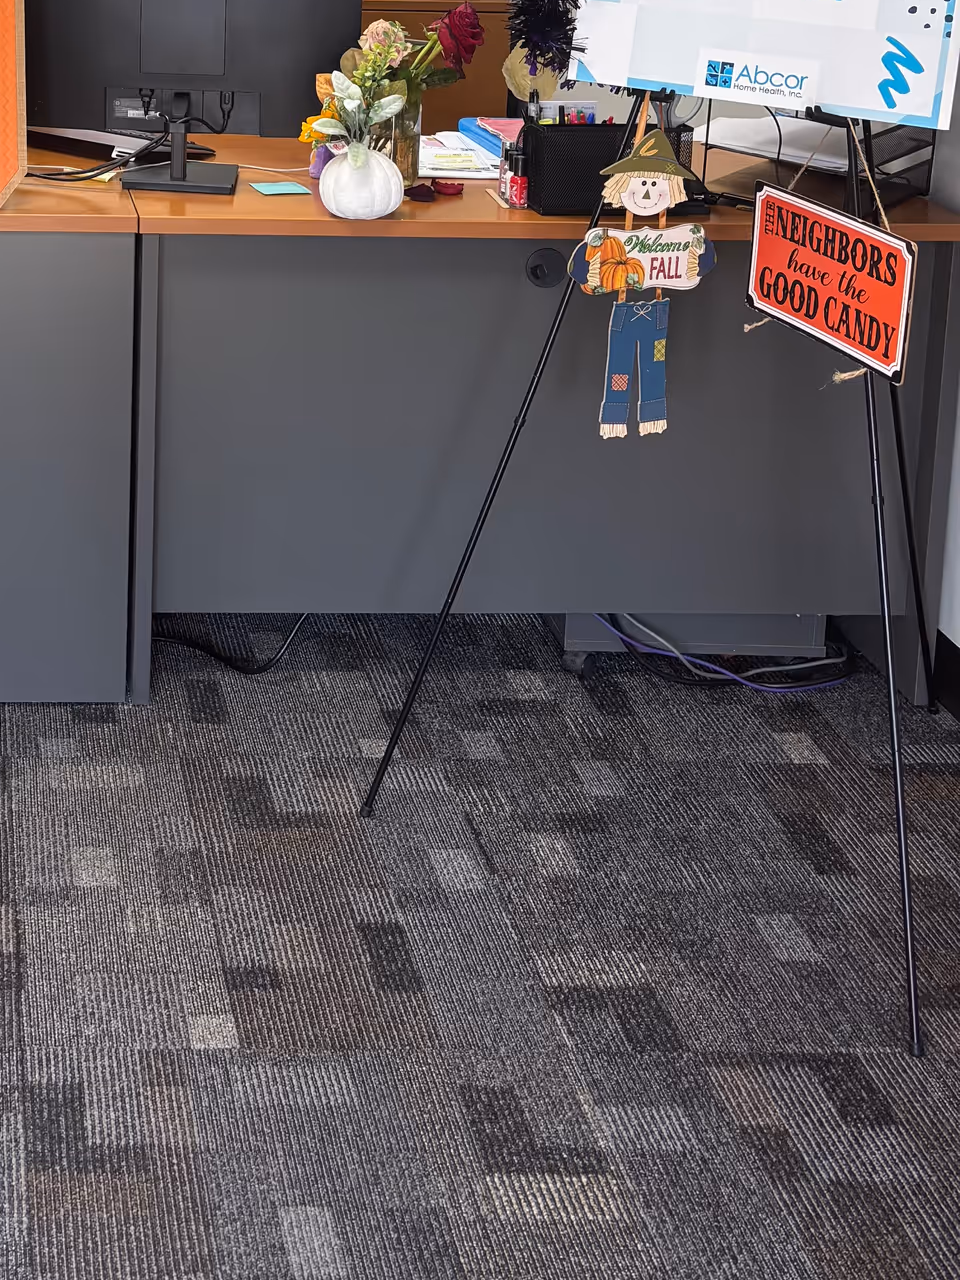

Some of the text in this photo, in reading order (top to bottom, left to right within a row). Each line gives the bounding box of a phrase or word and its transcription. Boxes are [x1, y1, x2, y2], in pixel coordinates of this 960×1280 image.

[733, 82, 803, 98] Home Health, Inc.
[735, 64, 808, 90] Abcor
[624, 233, 691, 254] Welcome
[764, 200, 898, 286] THE NEIGHBORS
[649, 256, 682, 280] FALL
[787, 248, 870, 304] have the
[759, 266, 896, 359] GOOD CANDY
